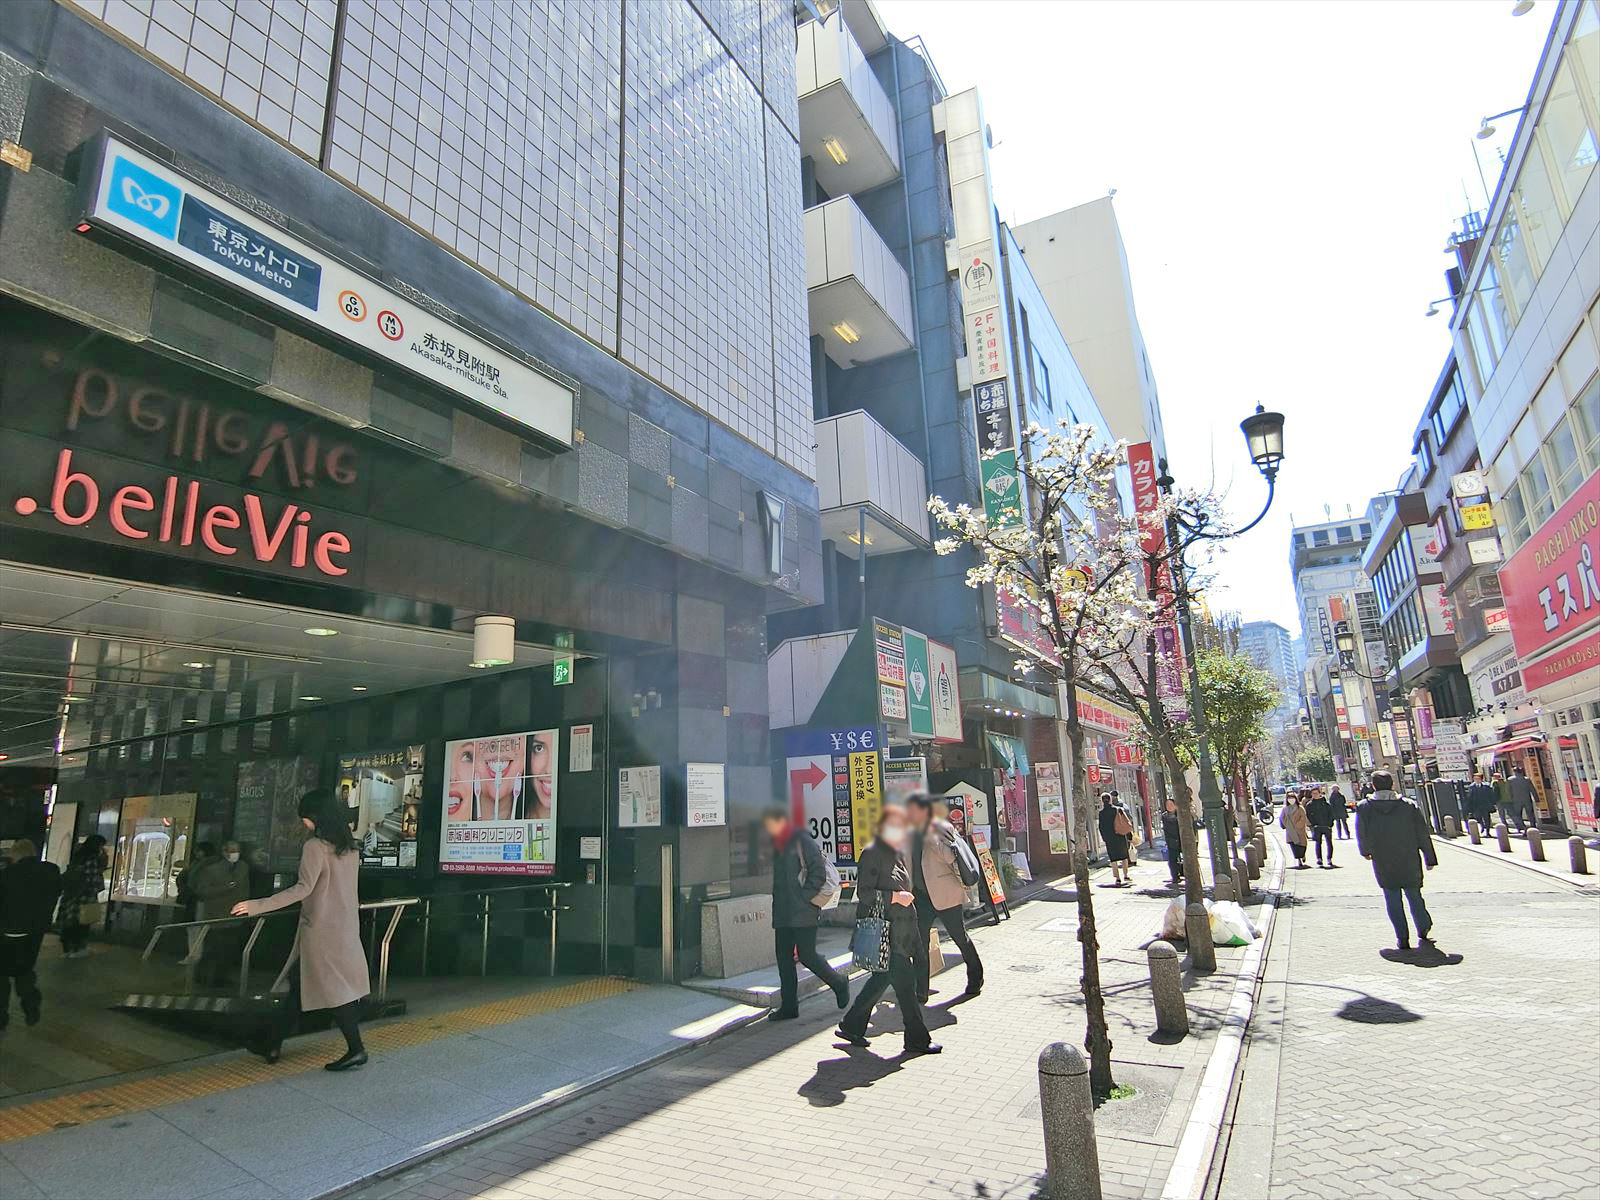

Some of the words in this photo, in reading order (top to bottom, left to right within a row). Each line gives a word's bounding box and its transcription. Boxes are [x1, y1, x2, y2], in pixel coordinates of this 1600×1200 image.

[207, 218, 300, 278] 東京メトロ
[213, 239, 253, 270] Tokyo
[254, 259, 293, 290] Metro
[345, 303, 360, 318] 05
[348, 295, 358, 306] G
[386, 314, 397, 326] M
[383, 321, 398, 337] 13
[986, 326, 1000, 373] 中国料理
[410, 342, 491, 392] Akasaka-mitsuke
[492, 384, 510, 400] Sta.
[423, 331, 501, 383] 赤坂見附駅
[1535, 500, 1598, 572] PACHINKO
[854, 756, 865, 800] 外币兑换
[865, 755, 875, 794] Money
[448, 828, 523, 842] 赤坂歯科クリニック
[810, 817, 832, 839] 30
